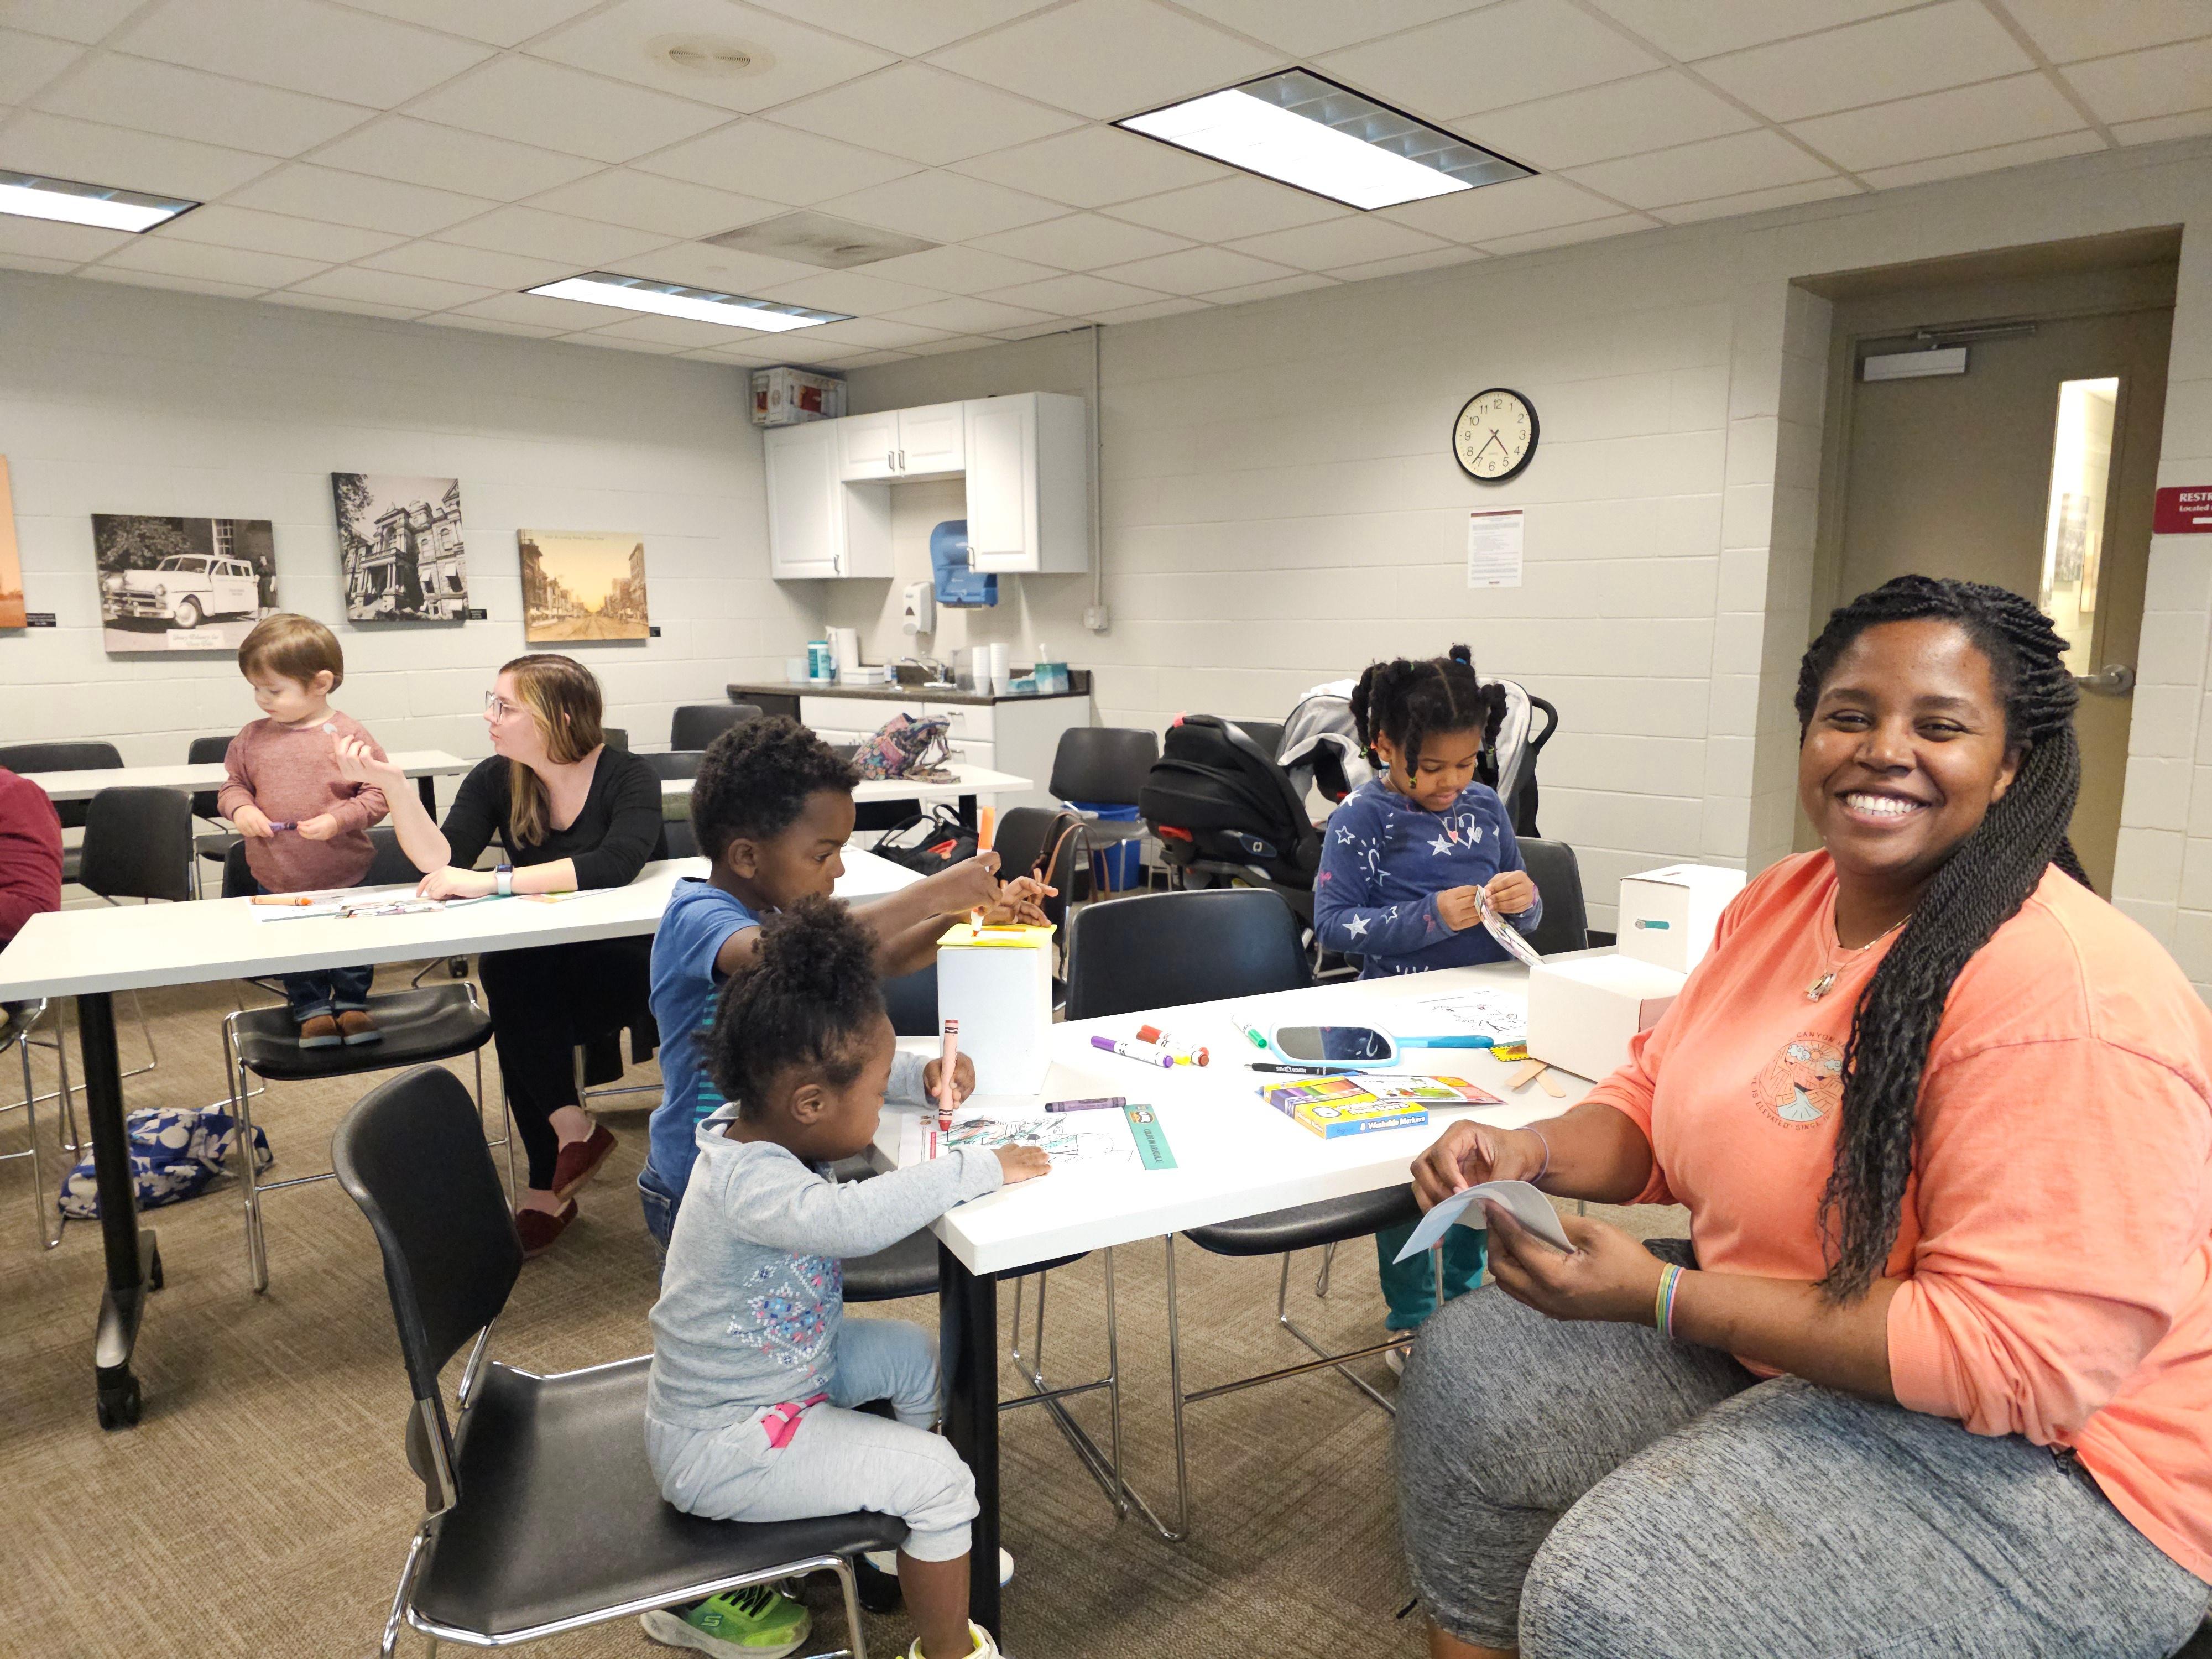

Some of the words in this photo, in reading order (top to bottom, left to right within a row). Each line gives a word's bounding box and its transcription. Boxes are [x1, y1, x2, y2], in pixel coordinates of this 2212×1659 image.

[1480, 404, 1488, 414] 11
[1494, 399, 1503, 409] 12
[1510, 403, 1513, 412] 1
[1469, 415, 1479, 426] 10
[1517, 413, 1524, 424] 2
[1464, 430, 1471, 441] 9
[1519, 429, 1526, 440] 3
[1467, 446, 1473, 456] 8
[1514, 445, 1520, 455] 4
[1477, 457, 1483, 467] 7
[1489, 461, 1495, 471] 6
[1503, 457, 1509, 467] 5
[1797, 1032, 1835, 1042] CANYON
[1311, 1106, 1342, 1118] 8
[1752, 1090, 1759, 1098] IS
[1756, 1101, 1790, 1128] ELEVATED
[1796, 1122, 1821, 1131] SINCE
[1360, 1122, 1366, 1131] 8
[1368, 1118, 1399, 1129] Washable
[1400, 1116, 1425, 1125] Markers
